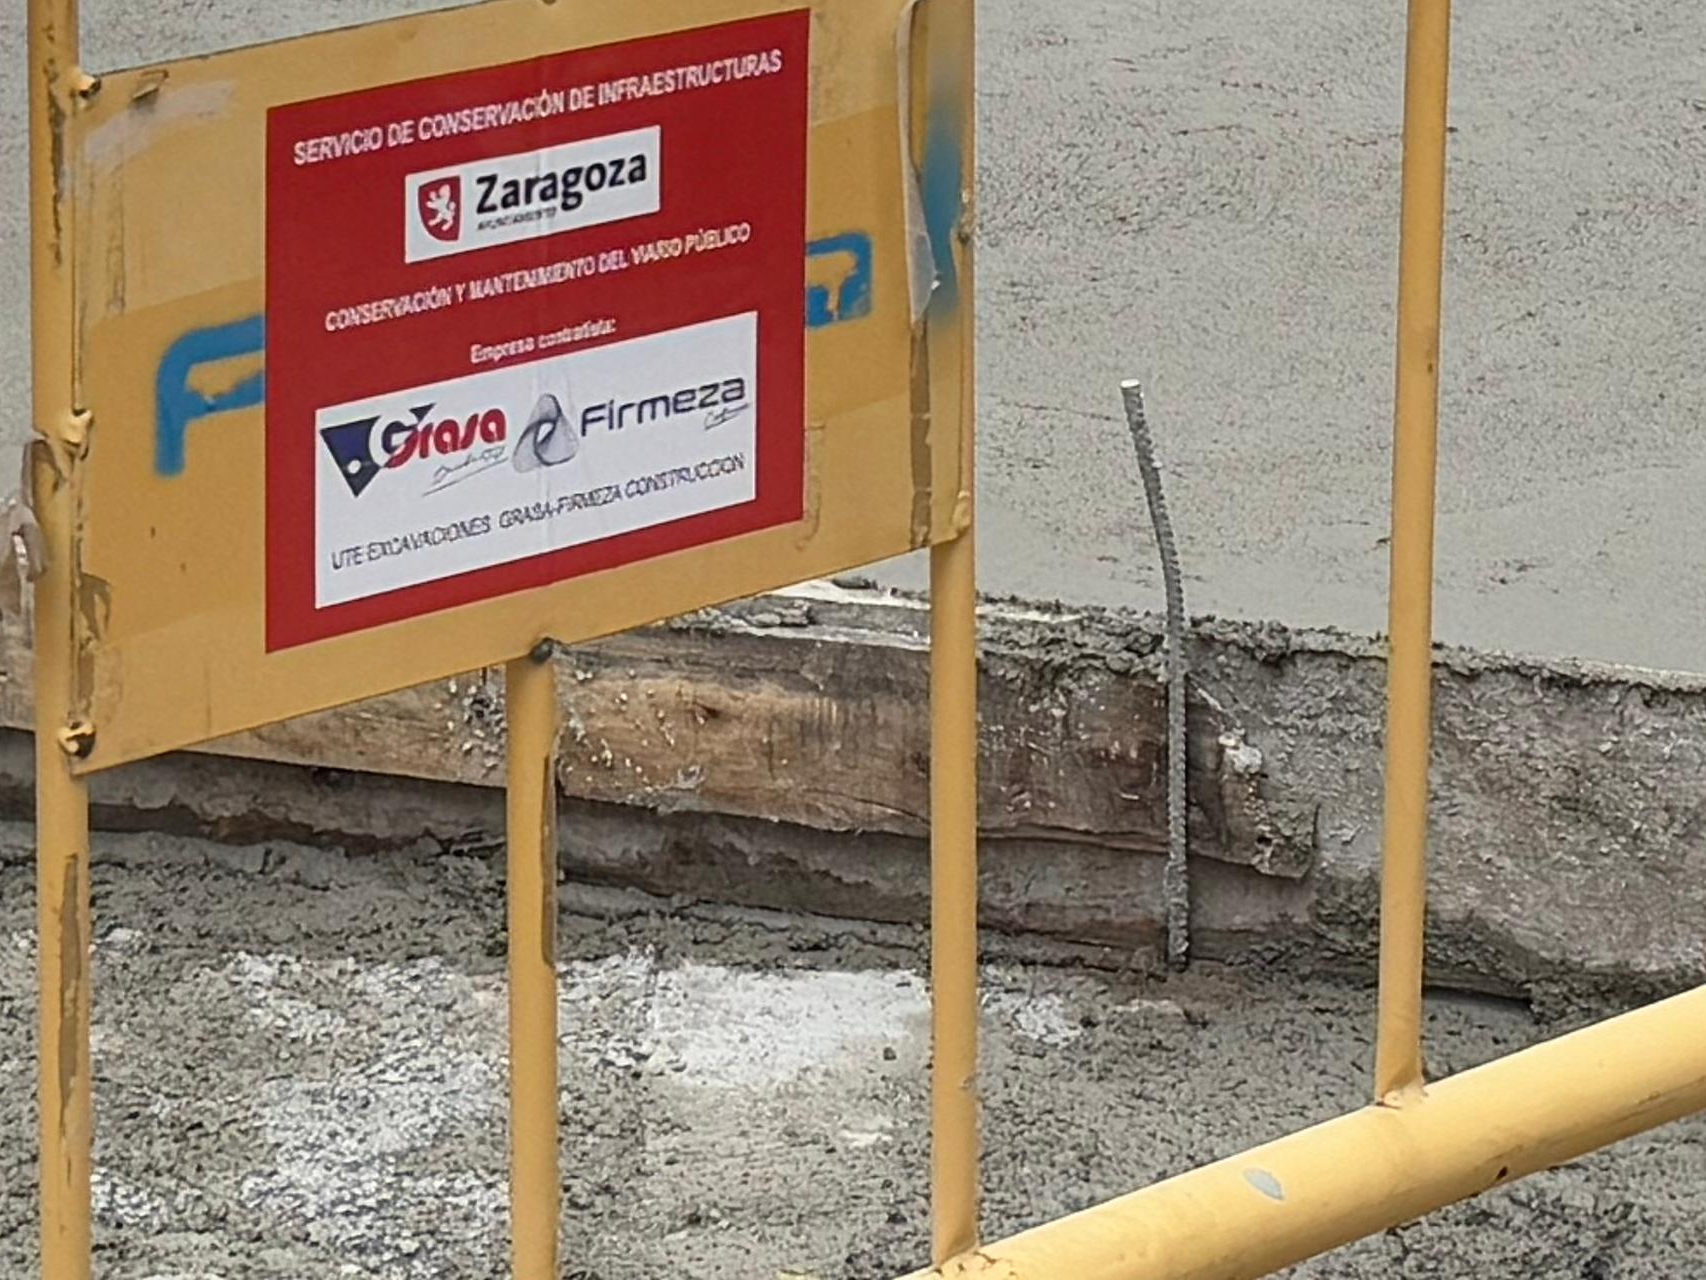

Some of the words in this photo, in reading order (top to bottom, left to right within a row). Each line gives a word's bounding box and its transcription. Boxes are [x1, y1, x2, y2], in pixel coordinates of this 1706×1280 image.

[294, 127, 383, 165] SERVICIO
[387, 120, 414, 147] DE
[418, 89, 564, 140] CONSERVACIÓN
[569, 85, 594, 111] DE
[598, 49, 782, 106] INFRAESTRUCTURAS
[476, 152, 646, 214] Zaragoza
[325, 286, 452, 332] CONSERVACIÓN
[456, 283, 466, 303] Y
[598, 248, 629, 273] DEL
[684, 222, 751, 254] PÚBLICO
[470, 334, 535, 364] Empresa
[381, 403, 507, 468] Grasa
[581, 377, 746, 437] Firmeza
[331, 546, 363, 571] UTE
[367, 514, 491, 561] EXCAVACIONES
